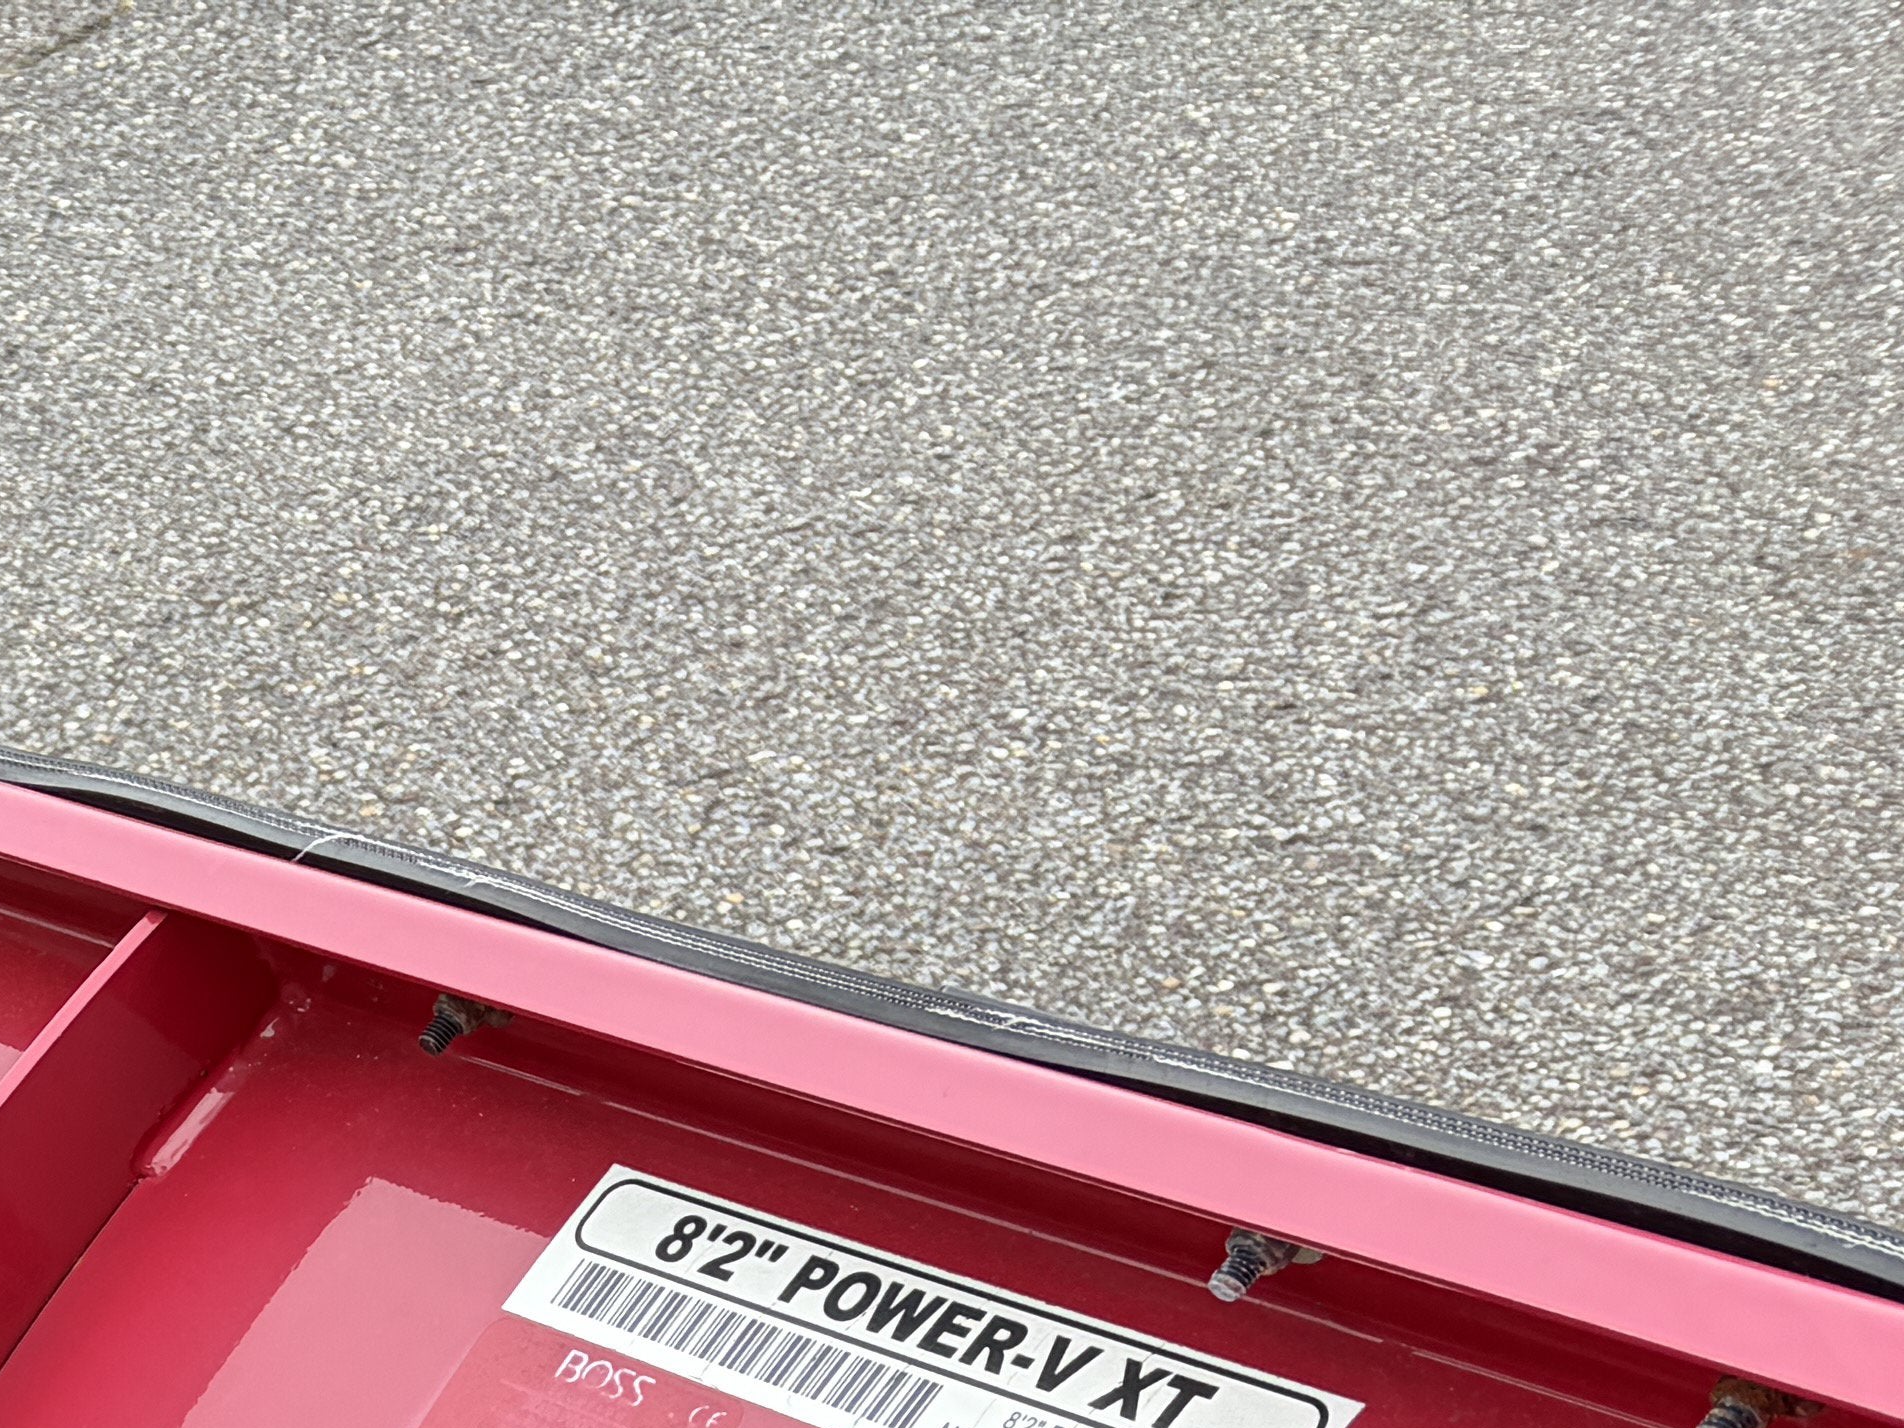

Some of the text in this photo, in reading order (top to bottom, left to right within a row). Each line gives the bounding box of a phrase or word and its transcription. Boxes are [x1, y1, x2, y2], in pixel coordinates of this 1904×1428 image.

[654, 1214, 787, 1283] 8'2"
[778, 1255, 1103, 1394] POWER-V
[554, 1348, 657, 1408] BOSS
